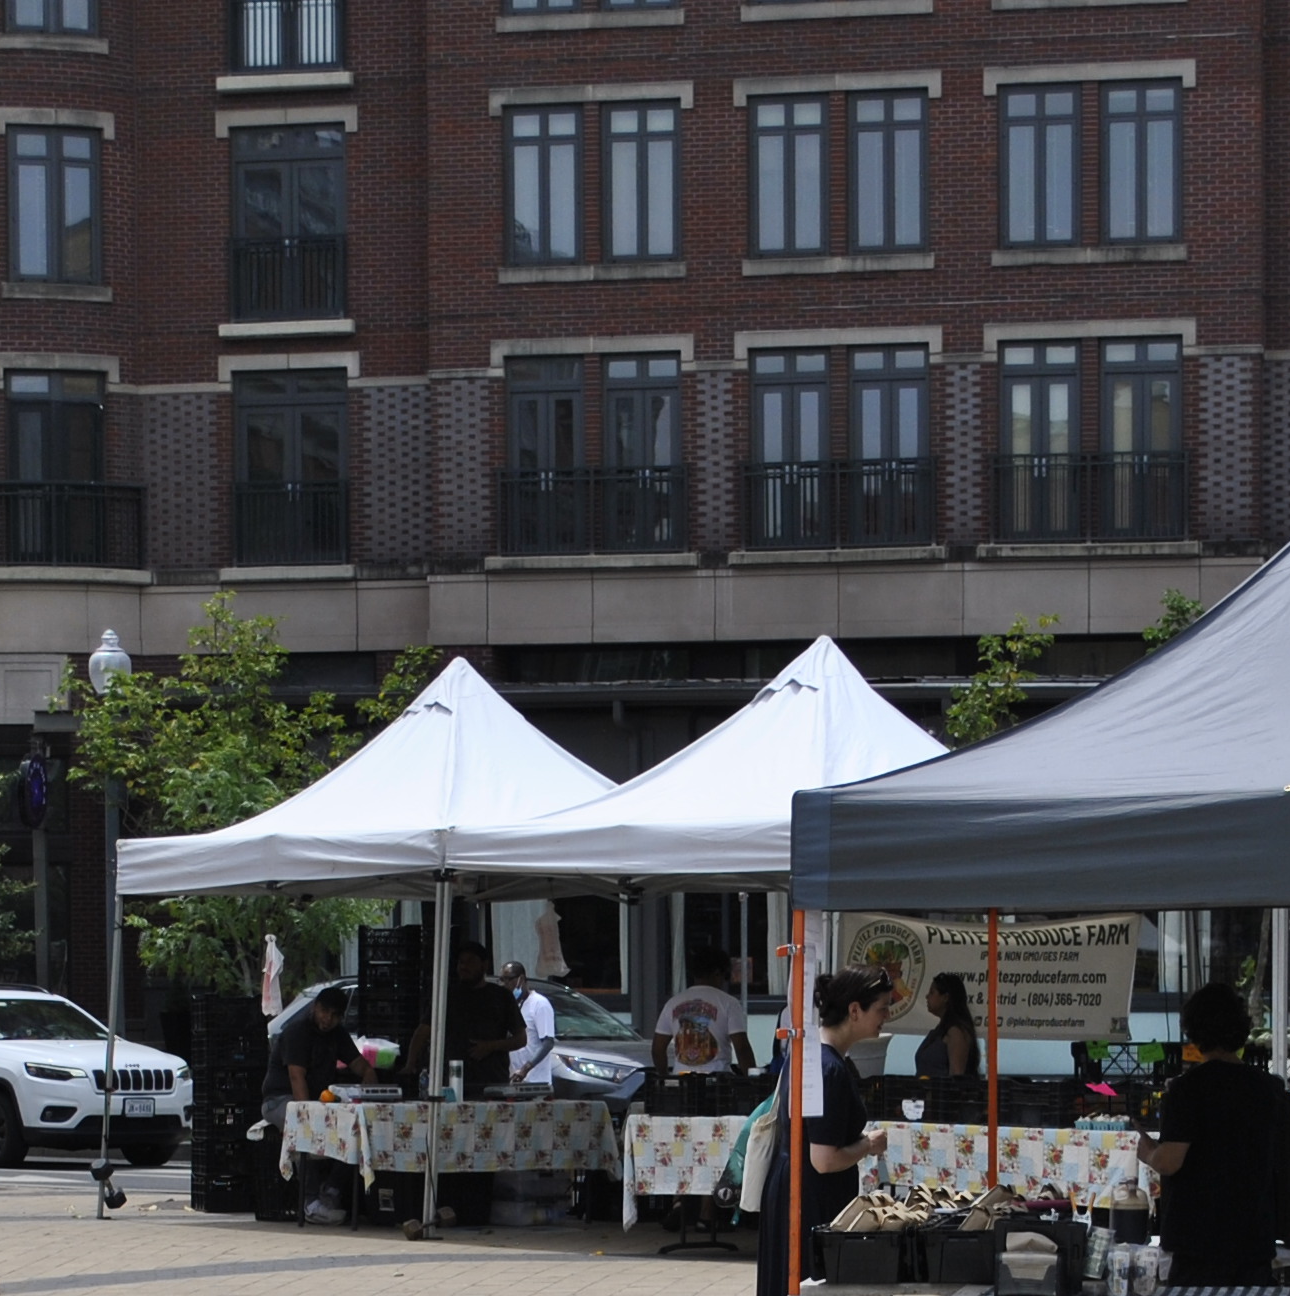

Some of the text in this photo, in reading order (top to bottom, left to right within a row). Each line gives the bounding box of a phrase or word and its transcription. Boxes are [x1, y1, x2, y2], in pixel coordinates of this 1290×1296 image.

[874, 924, 910, 941] PRODUCE
[926, 923, 1130, 946] PLEITE PRODUCE FARM
[1004, 952, 1021, 961] NON
[1023, 952, 1058, 962] GMO/GES
[1059, 951, 1080, 962] FARM
